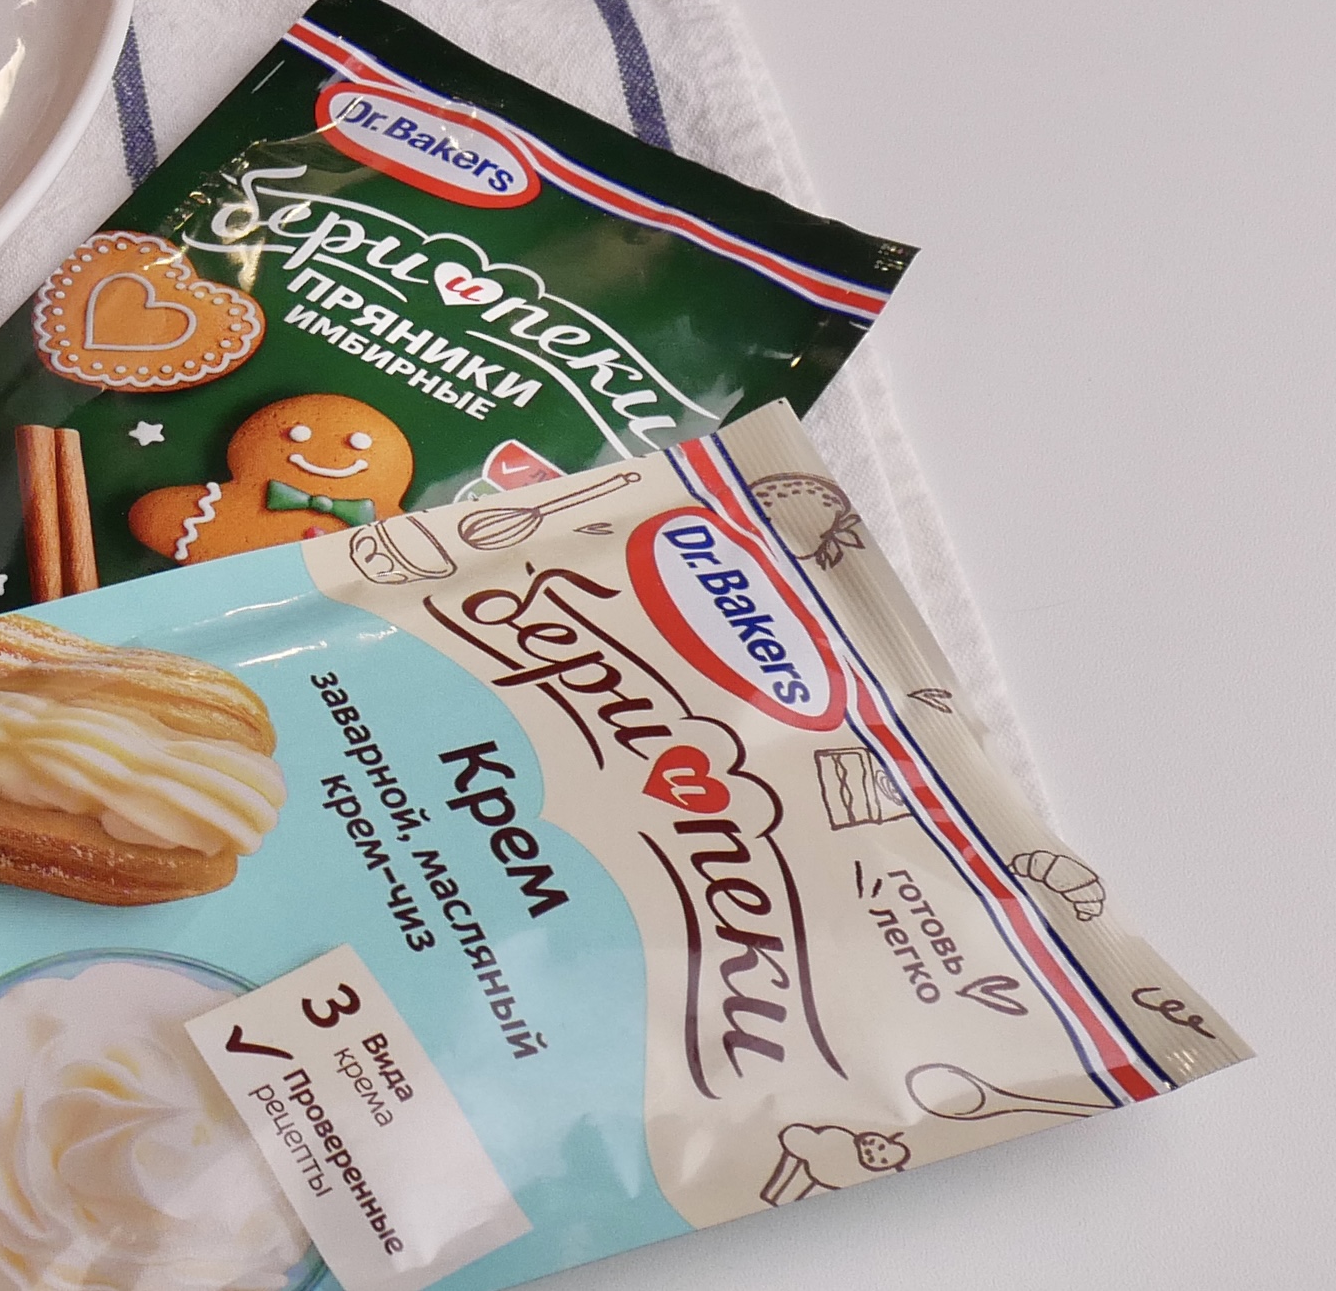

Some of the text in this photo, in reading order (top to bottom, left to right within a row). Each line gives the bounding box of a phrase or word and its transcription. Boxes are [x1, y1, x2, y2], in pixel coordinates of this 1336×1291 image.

[283, 304, 497, 421] ИМБИРНЫЕ
[286, 267, 543, 408] ПРЯНИКИ
[480, 296, 677, 450] пеки
[310, 671, 549, 1060] заварной, масляный
[320, 774, 436, 953] крем-чиз
[438, 740, 570, 919] Крем
[673, 819, 790, 1079] пеки
[868, 909, 941, 1005] легко
[887, 869, 965, 976] готовь
[301, 982, 362, 1029] 3
[248, 1083, 334, 1199] рецепты
[333, 1047, 394, 1129] крема
[282, 1068, 404, 1256] Проверенные
